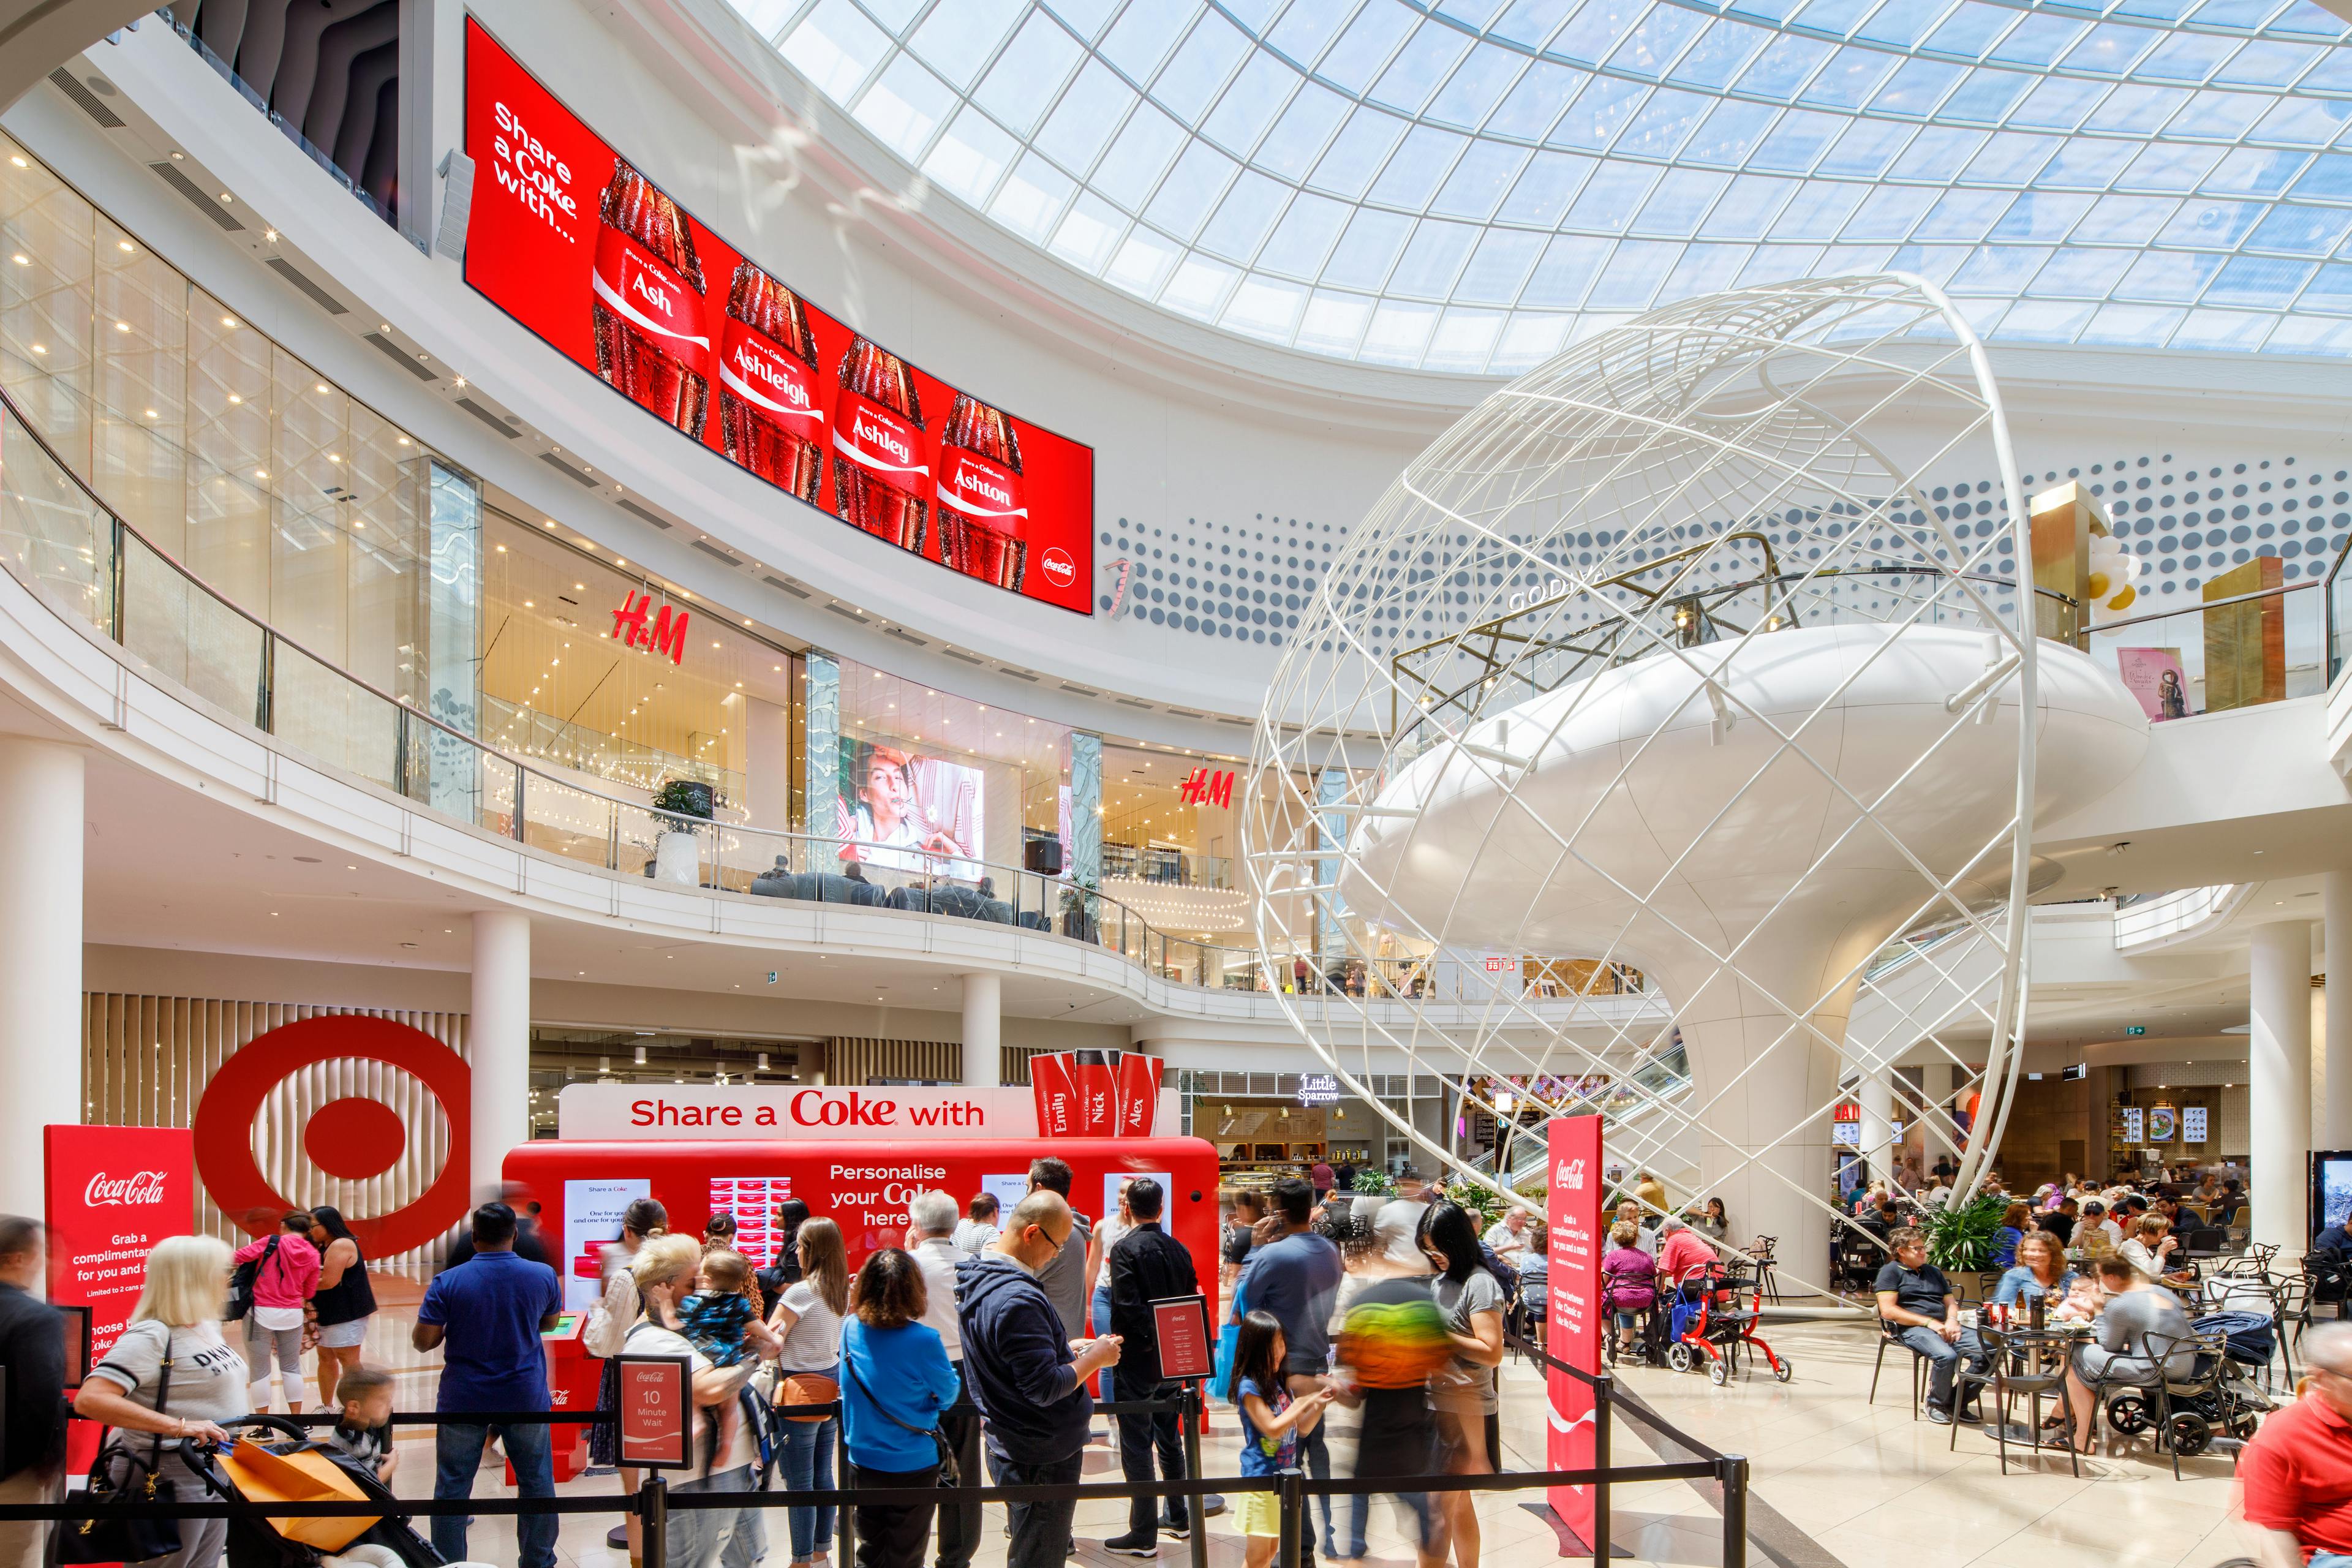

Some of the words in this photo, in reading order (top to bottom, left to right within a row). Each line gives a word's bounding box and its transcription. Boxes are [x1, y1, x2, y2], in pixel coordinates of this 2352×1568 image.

[495, 102, 571, 184] Share
[494, 135, 511, 163] a
[516, 150, 577, 220] Coke
[494, 160, 575, 243] with...
[625, 247, 643, 264] Share
[649, 264, 669, 284] Coke
[668, 281, 682, 295] with
[633, 272, 673, 317] Ash
[748, 337, 764, 351] Share
[769, 349, 786, 366] Coke
[785, 363, 797, 374] with
[734, 345, 811, 409] Ashleigh
[859, 405, 873, 417] Share
[878, 413, 894, 428] Coke
[894, 425, 905, 434] with
[853, 417, 909, 464] Ashley
[961, 458, 975, 467] Share
[979, 464, 995, 477] Coke
[994, 473, 1005, 481] with
[954, 467, 1011, 507] Ashton
[1044, 559, 1074, 576] Coca-Cola
[612, 590, 690, 666] H&M
[1180, 766, 1235, 810] H&M
[1302, 1074, 1336, 1090] Little
[631, 1099, 742, 1126] Share
[755, 1106, 777, 1126] a
[790, 1090, 896, 1126] Coke
[910, 1101, 984, 1126] with
[1092, 1091, 1104, 1123] Nick
[1298, 1090, 1338, 1107] Sparrow
[1052, 1093, 1067, 1133] Emily
[1129, 1098, 1144, 1128] Alex
[831, 1164, 946, 1180] Personalise
[1556, 1159, 1585, 1189] Coca-Cola
[85, 1171, 168, 1207] Coca-Cola
[831, 1192, 879, 1208] your
[864, 1211, 909, 1226] here
[1564, 1214, 1572, 1224] Grab
[111, 1233, 138, 1245] Grab
[1552, 1227, 1579, 1241] complimentary
[1579, 1229, 1589, 1241] Coke
[1577, 1246, 1587, 1256] mate
[78, 1270, 94, 1281] for
[97, 1267, 118, 1281] you
[121, 1264, 140, 1275] and
[87, 1289, 111, 1297] Limited
[1554, 1286, 1567, 1299] Choose
[1567, 1291, 1584, 1306] between
[1564, 1303, 1577, 1317] Classic
[1577, 1310, 1582, 1319] or
[1564, 1318, 1569, 1328] No
[1569, 1320, 1581, 1333] Sugar
[636, 1372, 664, 1382] Coca-Cola
[643, 1390, 660, 1404] 10
